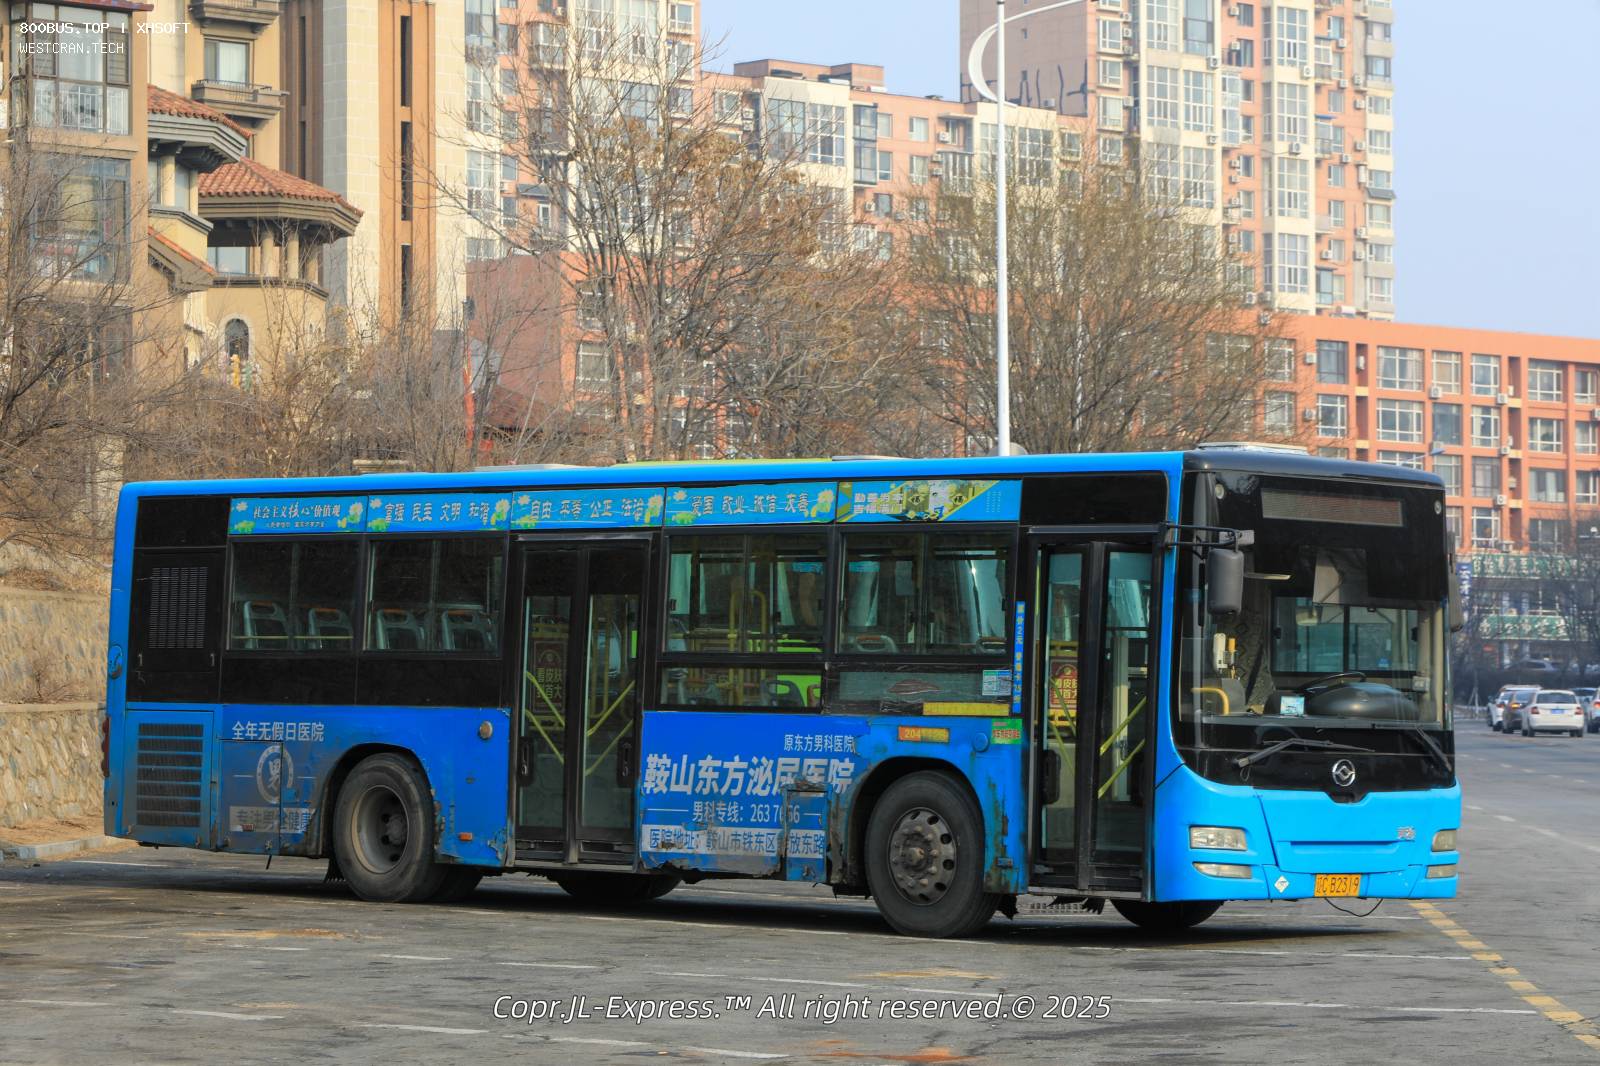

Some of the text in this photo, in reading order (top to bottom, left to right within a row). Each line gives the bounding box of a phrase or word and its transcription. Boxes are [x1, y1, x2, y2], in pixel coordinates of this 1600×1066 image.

[232, 720, 325, 741] 全年无假日医院
[784, 734, 856, 753] 原东方男科医院
[643, 754, 855, 796] 鞍山东方泌尿医院
